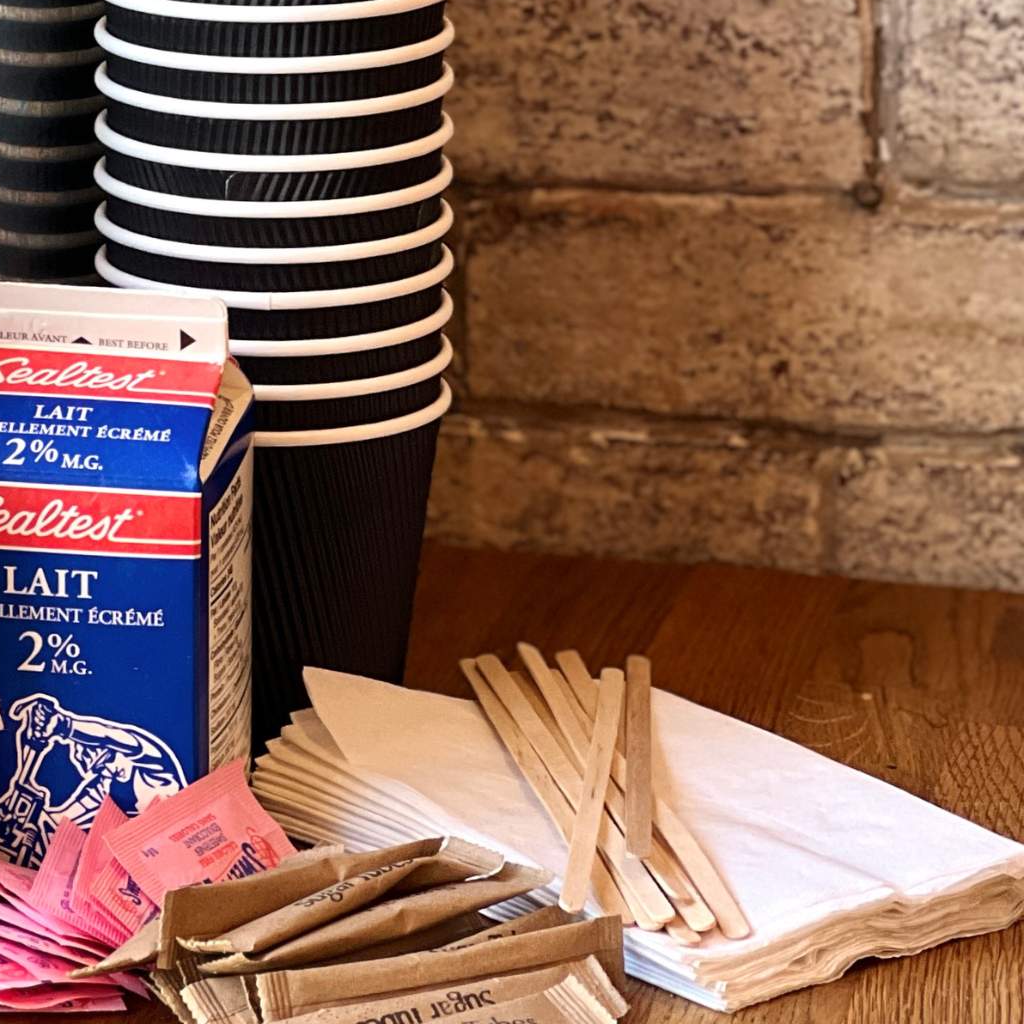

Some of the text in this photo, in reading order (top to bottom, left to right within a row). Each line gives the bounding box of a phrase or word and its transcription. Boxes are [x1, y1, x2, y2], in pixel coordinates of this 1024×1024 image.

[31, 333, 68, 344] AVANT
[99, 338, 169, 351] BEST BEFORE
[34, 404, 93, 422] LAIT
[96, 425, 172, 443] ÉCRÉMÉ
[2, 437, 59, 466] 2%
[61, 454, 104, 471] M.G.
[3, 565, 99, 599] LAIT
[87, 606, 165, 627] ÉCRÉMÉ
[17, 630, 81, 673] 2%
[50, 659, 94, 676] M.G.
